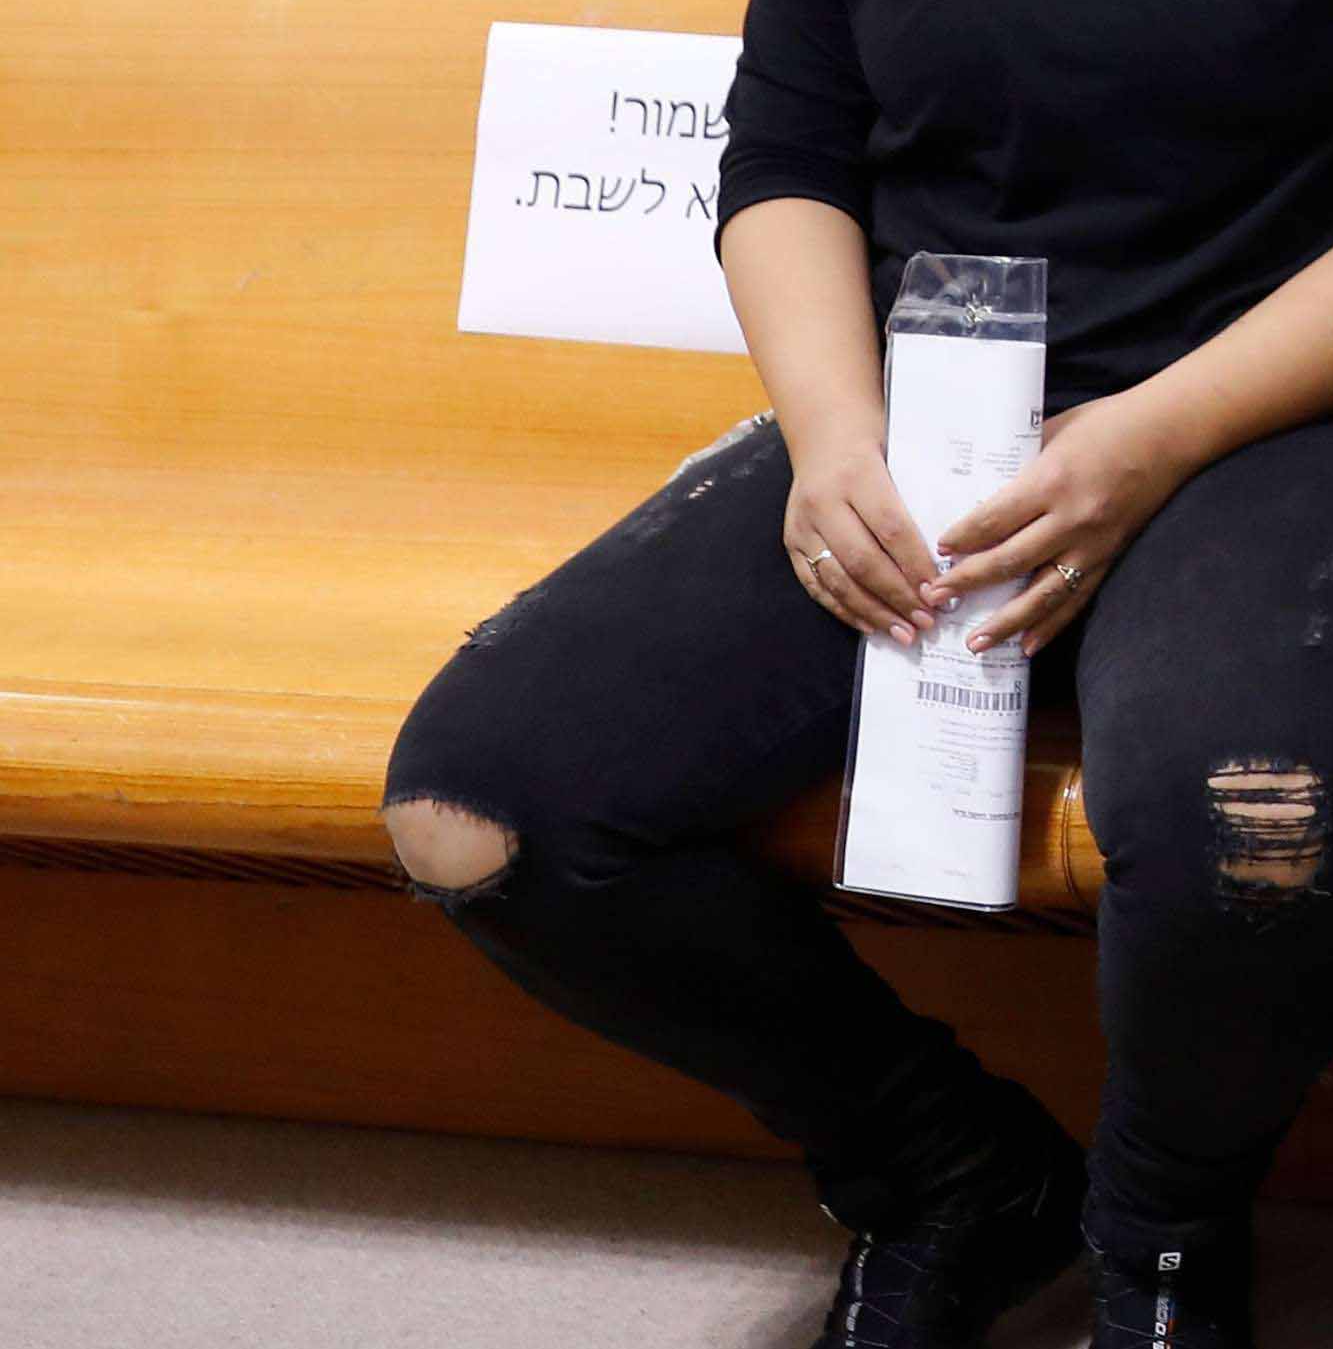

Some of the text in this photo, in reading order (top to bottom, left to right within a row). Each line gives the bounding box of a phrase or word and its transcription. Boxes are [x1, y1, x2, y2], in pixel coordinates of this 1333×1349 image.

[609, 90, 730, 140] שמור!
[515, 167, 717, 220] א לשבת.
